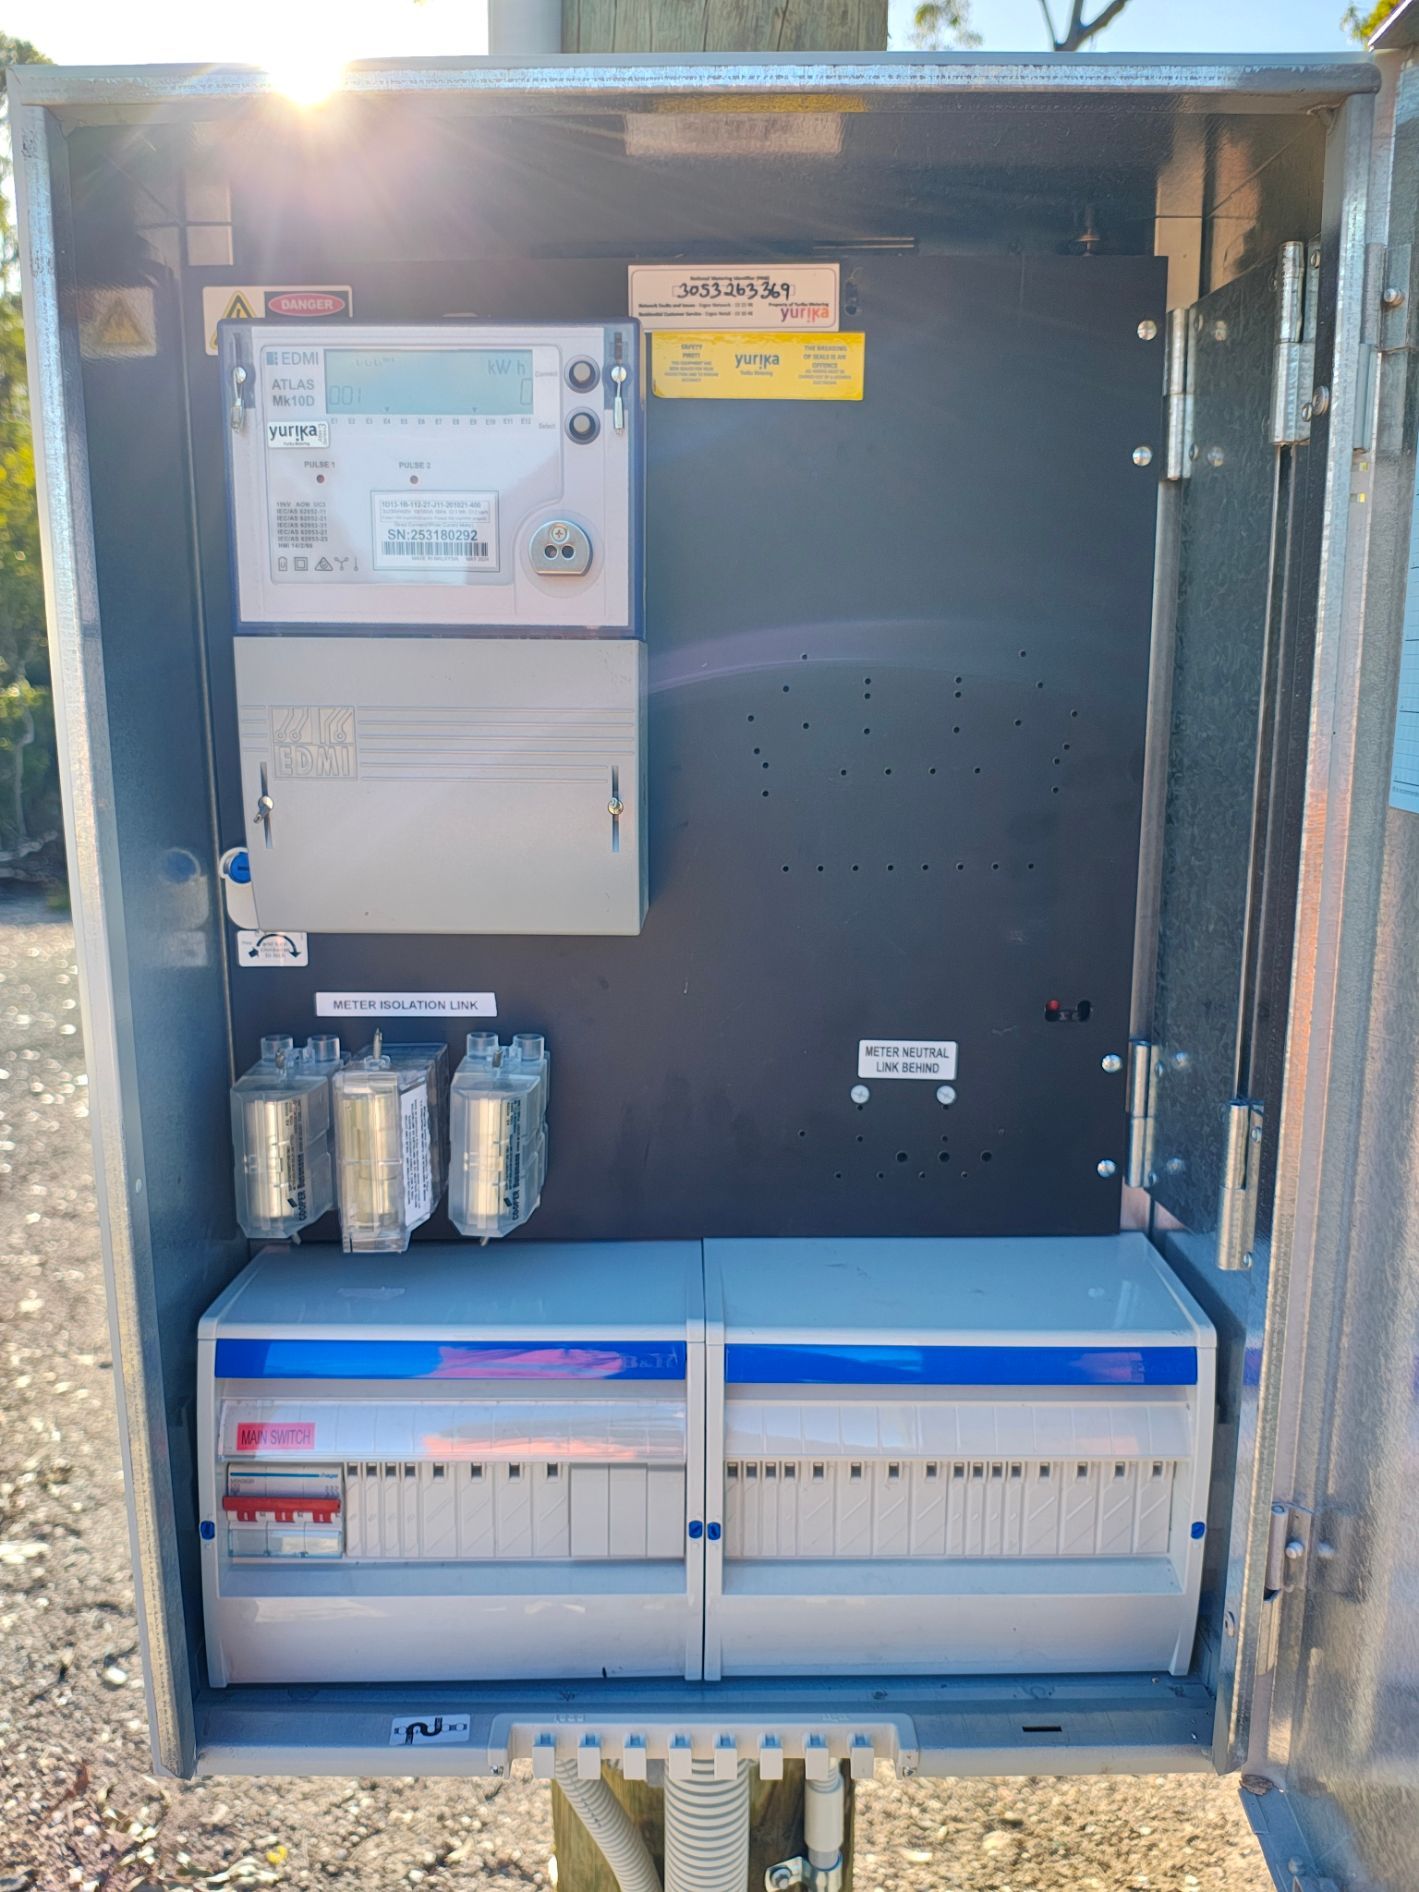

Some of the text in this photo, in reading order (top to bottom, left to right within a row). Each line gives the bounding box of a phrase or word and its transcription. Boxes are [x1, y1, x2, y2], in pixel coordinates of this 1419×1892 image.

[281, 299, 334, 310] DANGER
[781, 306, 829, 323] yurika
[281, 351, 319, 366] EDMI
[735, 353, 779, 369] yurika
[272, 379, 315, 390] ATLAS
[272, 395, 315, 407] Mk10D
[269, 425, 317, 441] yurika
[399, 461, 424, 469] PULSE
[387, 528, 478, 541] SN:253180292
[279, 744, 350, 776] EDMI
[333, 1000, 478, 1010] METER ISOLATION LINK
[865, 1046, 950, 1059] METER NEUTRAL
[876, 1061, 940, 1074] LINK BEHIND
[241, 1429, 311, 1445] MAIN SWITCH
